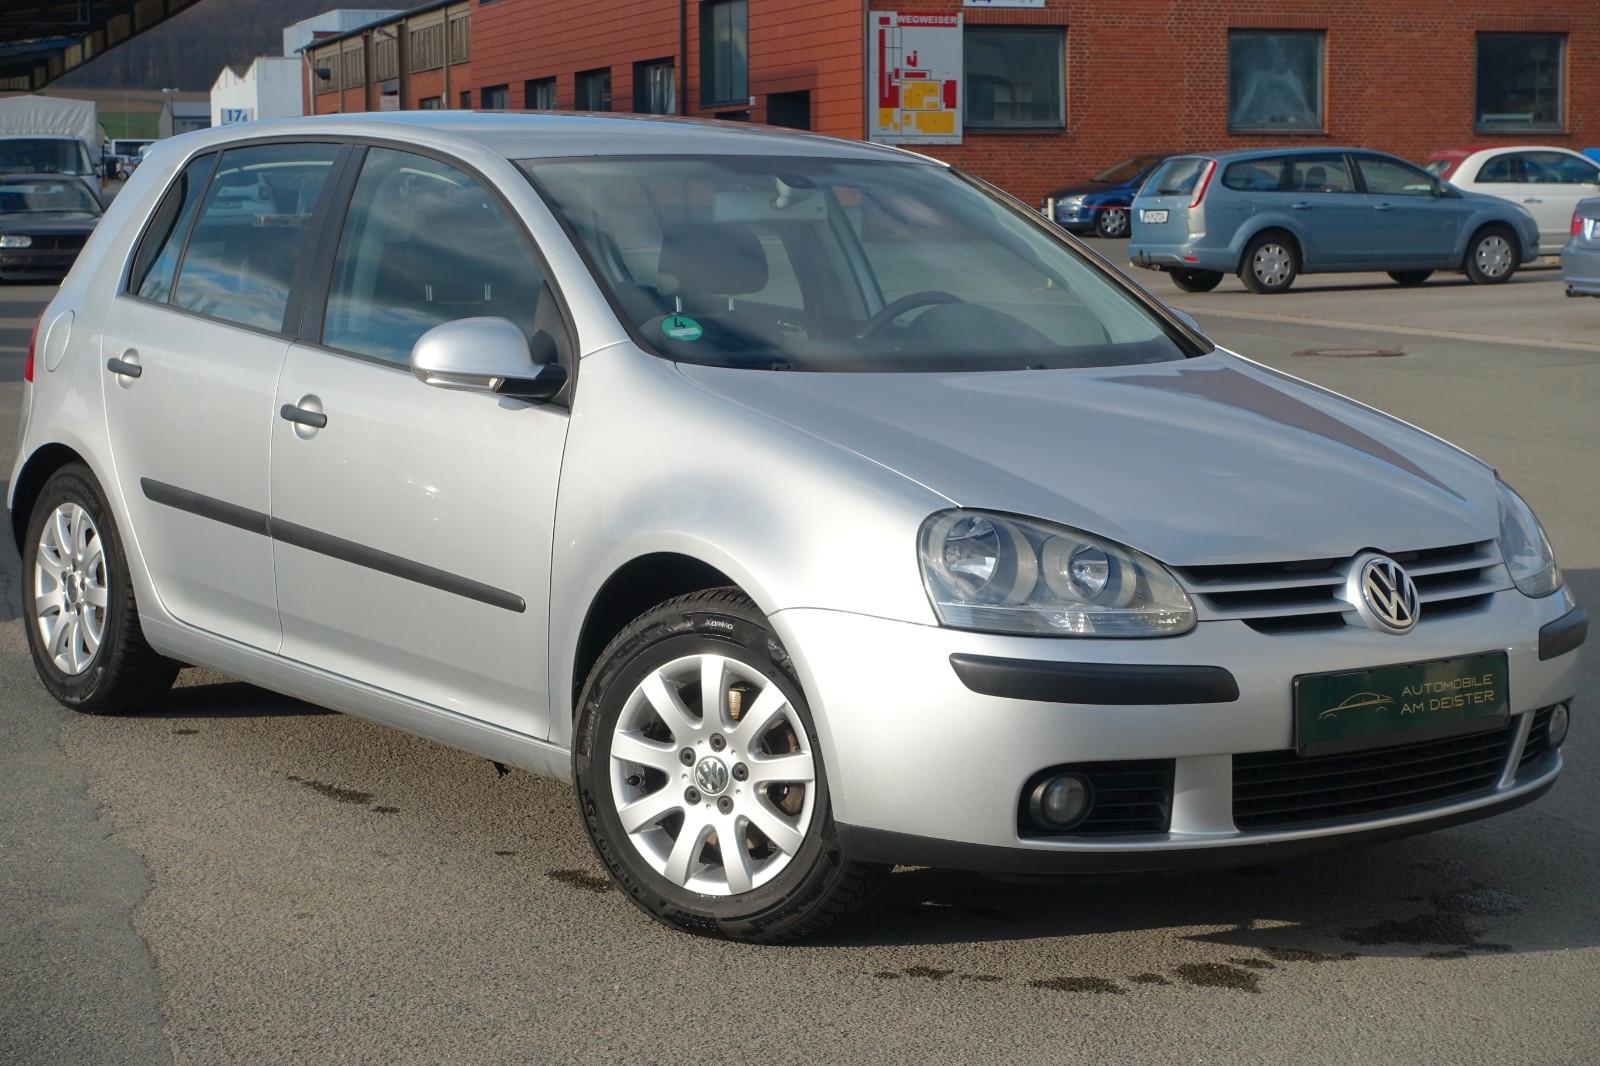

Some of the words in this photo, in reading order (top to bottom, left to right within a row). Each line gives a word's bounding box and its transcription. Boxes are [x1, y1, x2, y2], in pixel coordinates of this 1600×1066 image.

[897, 15, 958, 24] WEGWEISER
[674, 317, 686, 328] 4
[1401, 674, 1493, 697] AUTOMOBILE
[1400, 702, 1424, 716] AM
[1430, 690, 1495, 711] DEISTER
